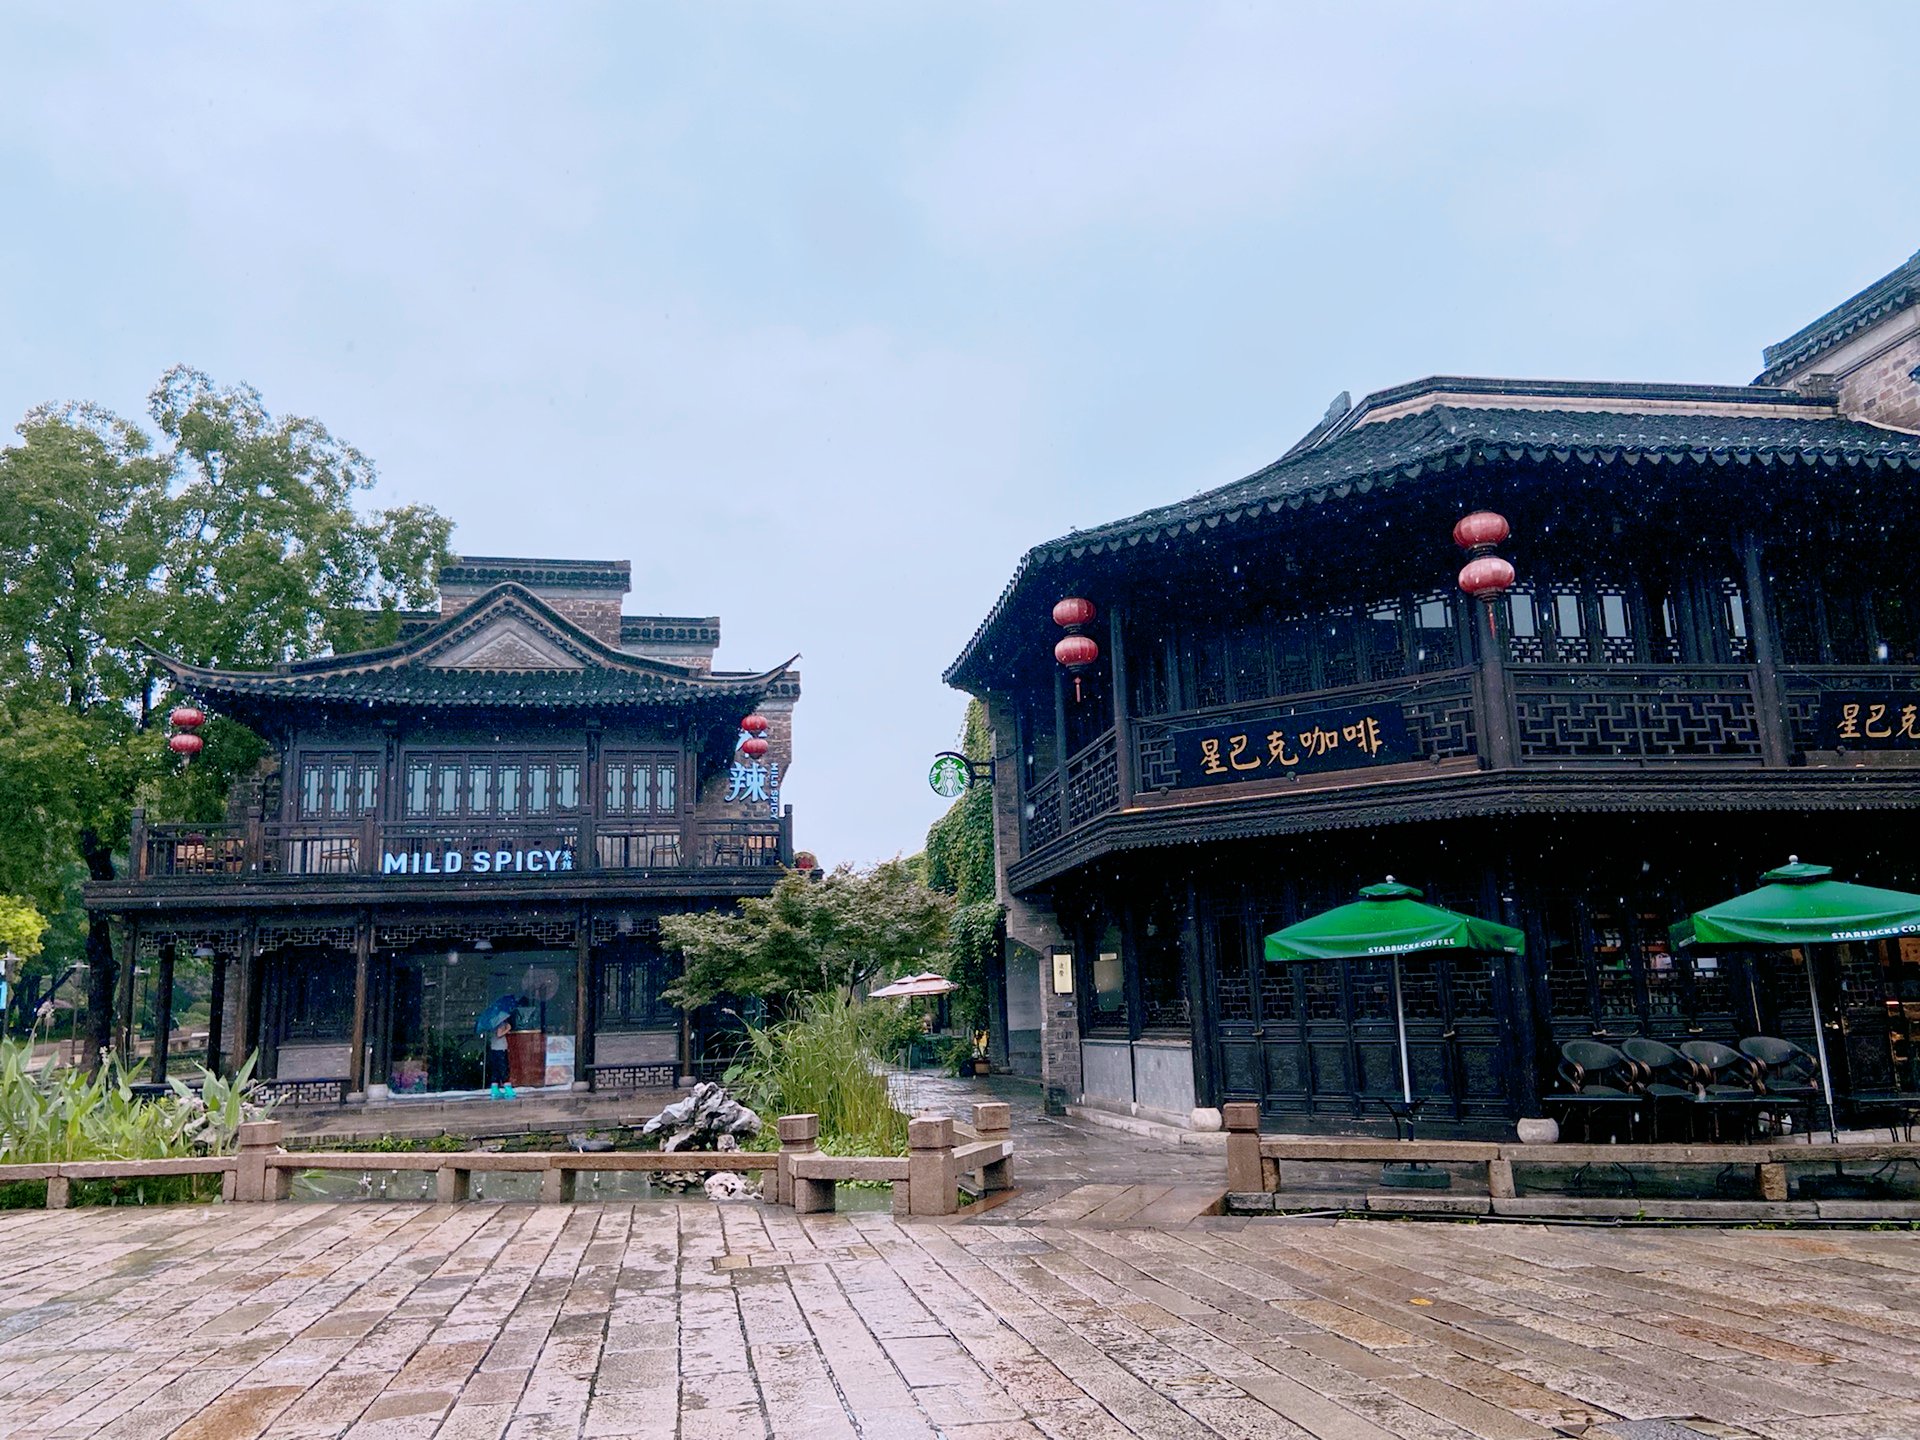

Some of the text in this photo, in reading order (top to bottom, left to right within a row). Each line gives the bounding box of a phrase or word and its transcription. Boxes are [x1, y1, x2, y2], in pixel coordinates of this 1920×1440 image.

[1837, 703, 1920, 739] 星巴克
[1200, 716, 1384, 775] 星巴克咖啡
[770, 762, 779, 820] MILD SPICY
[383, 849, 562, 875] MILD SPICY
[1367, 938, 1455, 954] STARBUCKS COFFEE
[1831, 927, 1900, 940] STARBUCKS
